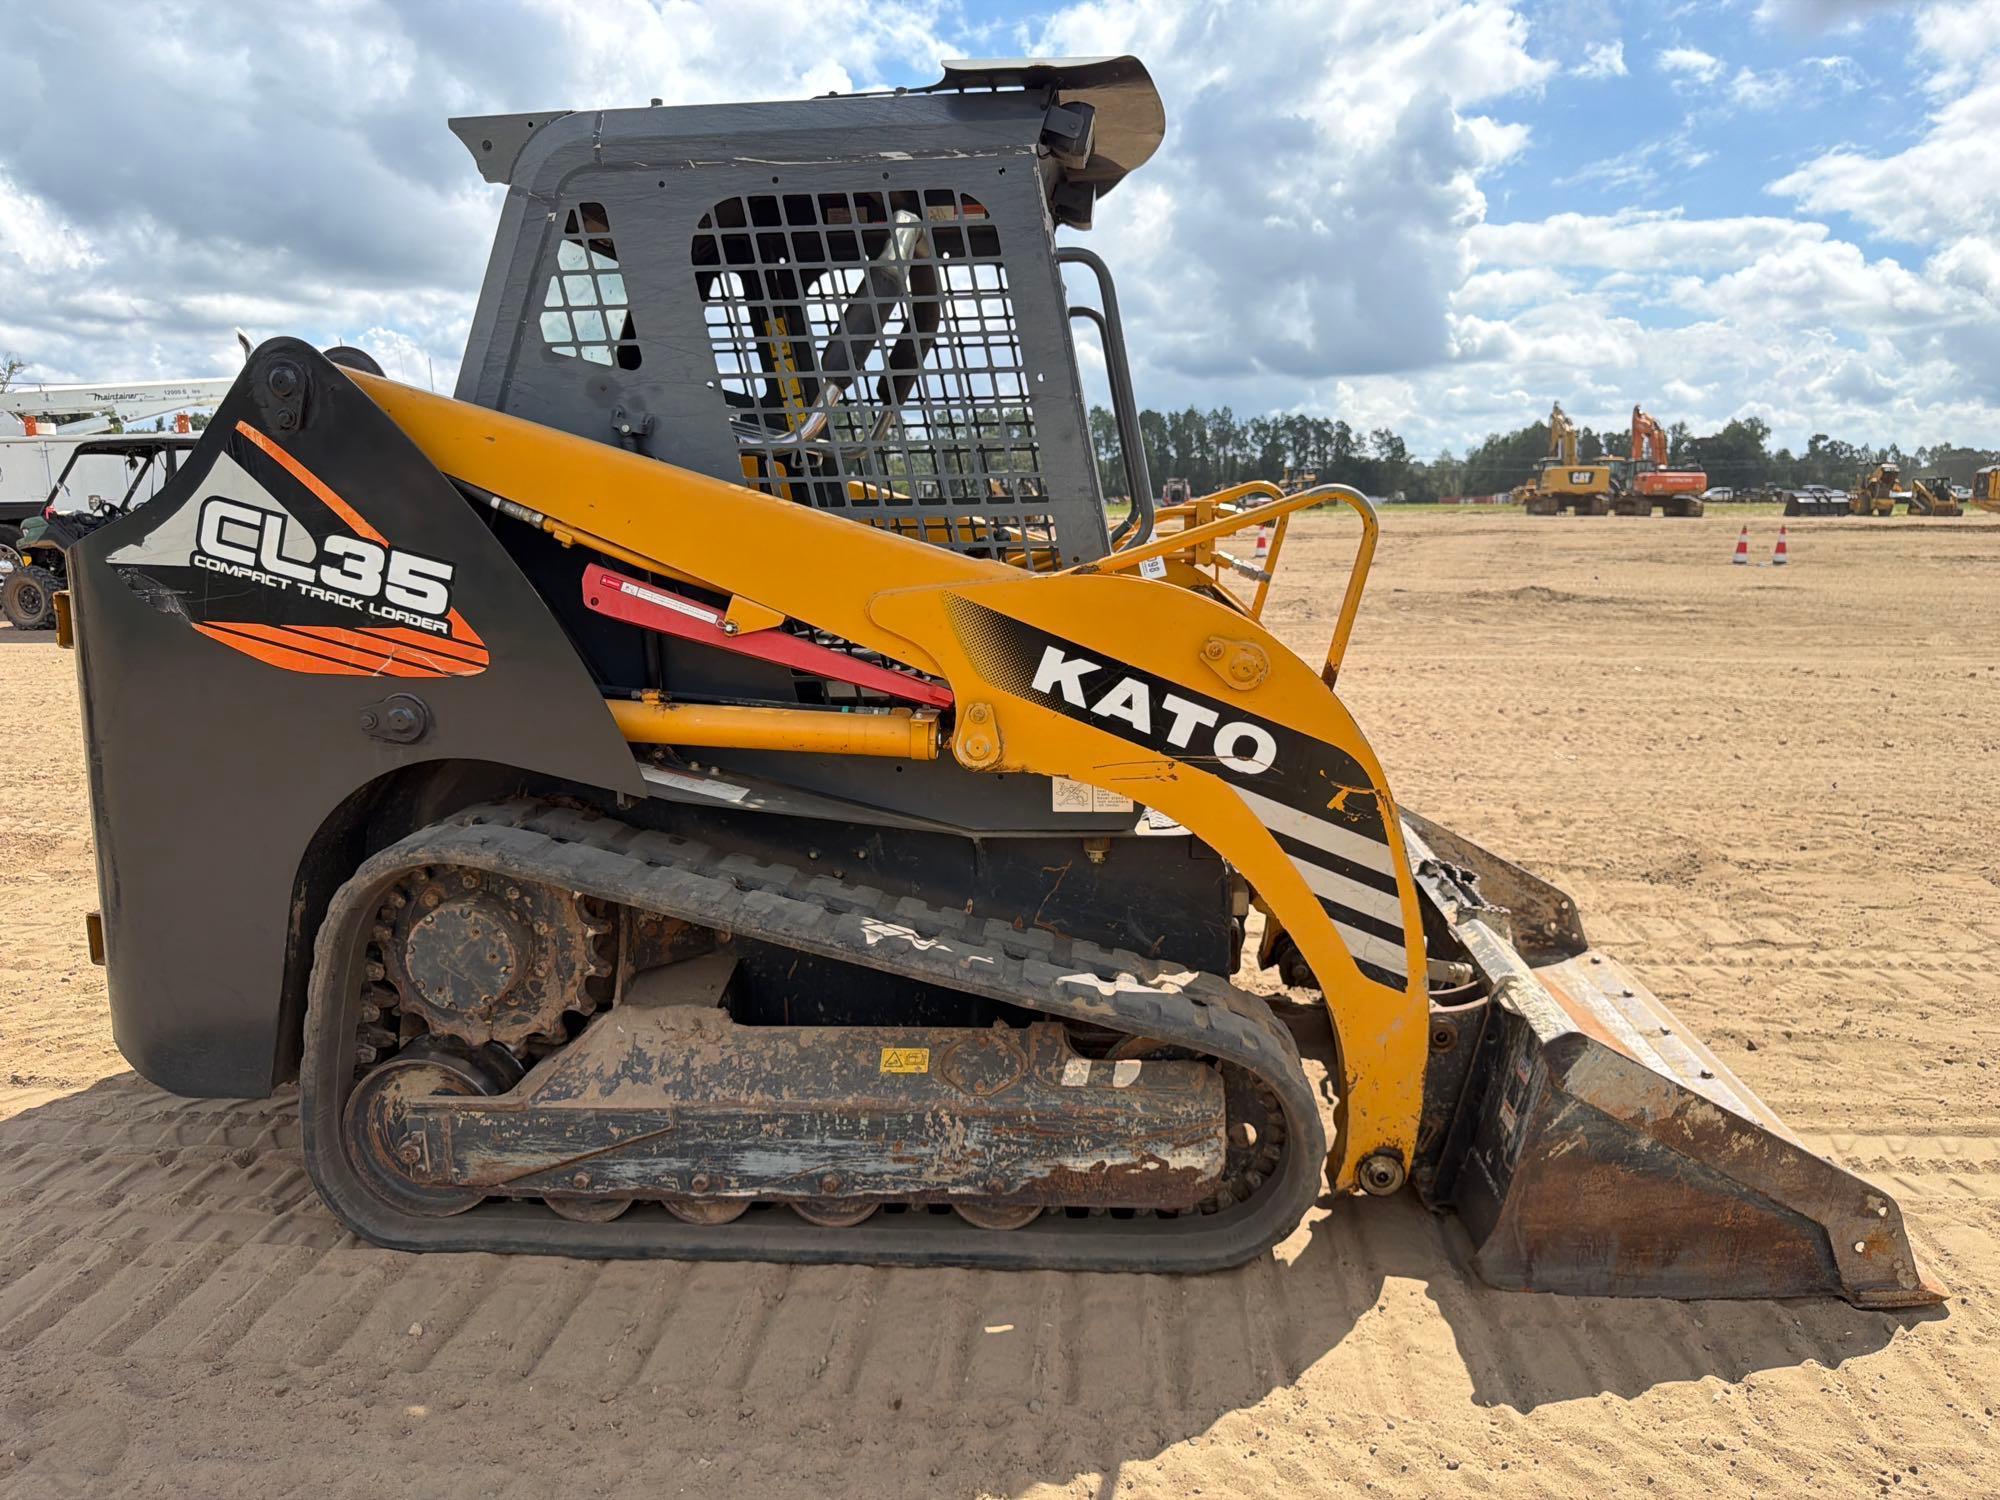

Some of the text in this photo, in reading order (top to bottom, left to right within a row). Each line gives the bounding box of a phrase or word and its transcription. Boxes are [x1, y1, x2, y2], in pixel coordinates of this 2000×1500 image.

[87, 392, 144, 401] Maintainer
[1572, 471, 1591, 484] CAT
[193, 554, 449, 635] COMPACT TRACK LOADER
[199, 499, 454, 616] CL35
[1031, 645, 1278, 775] KATO
